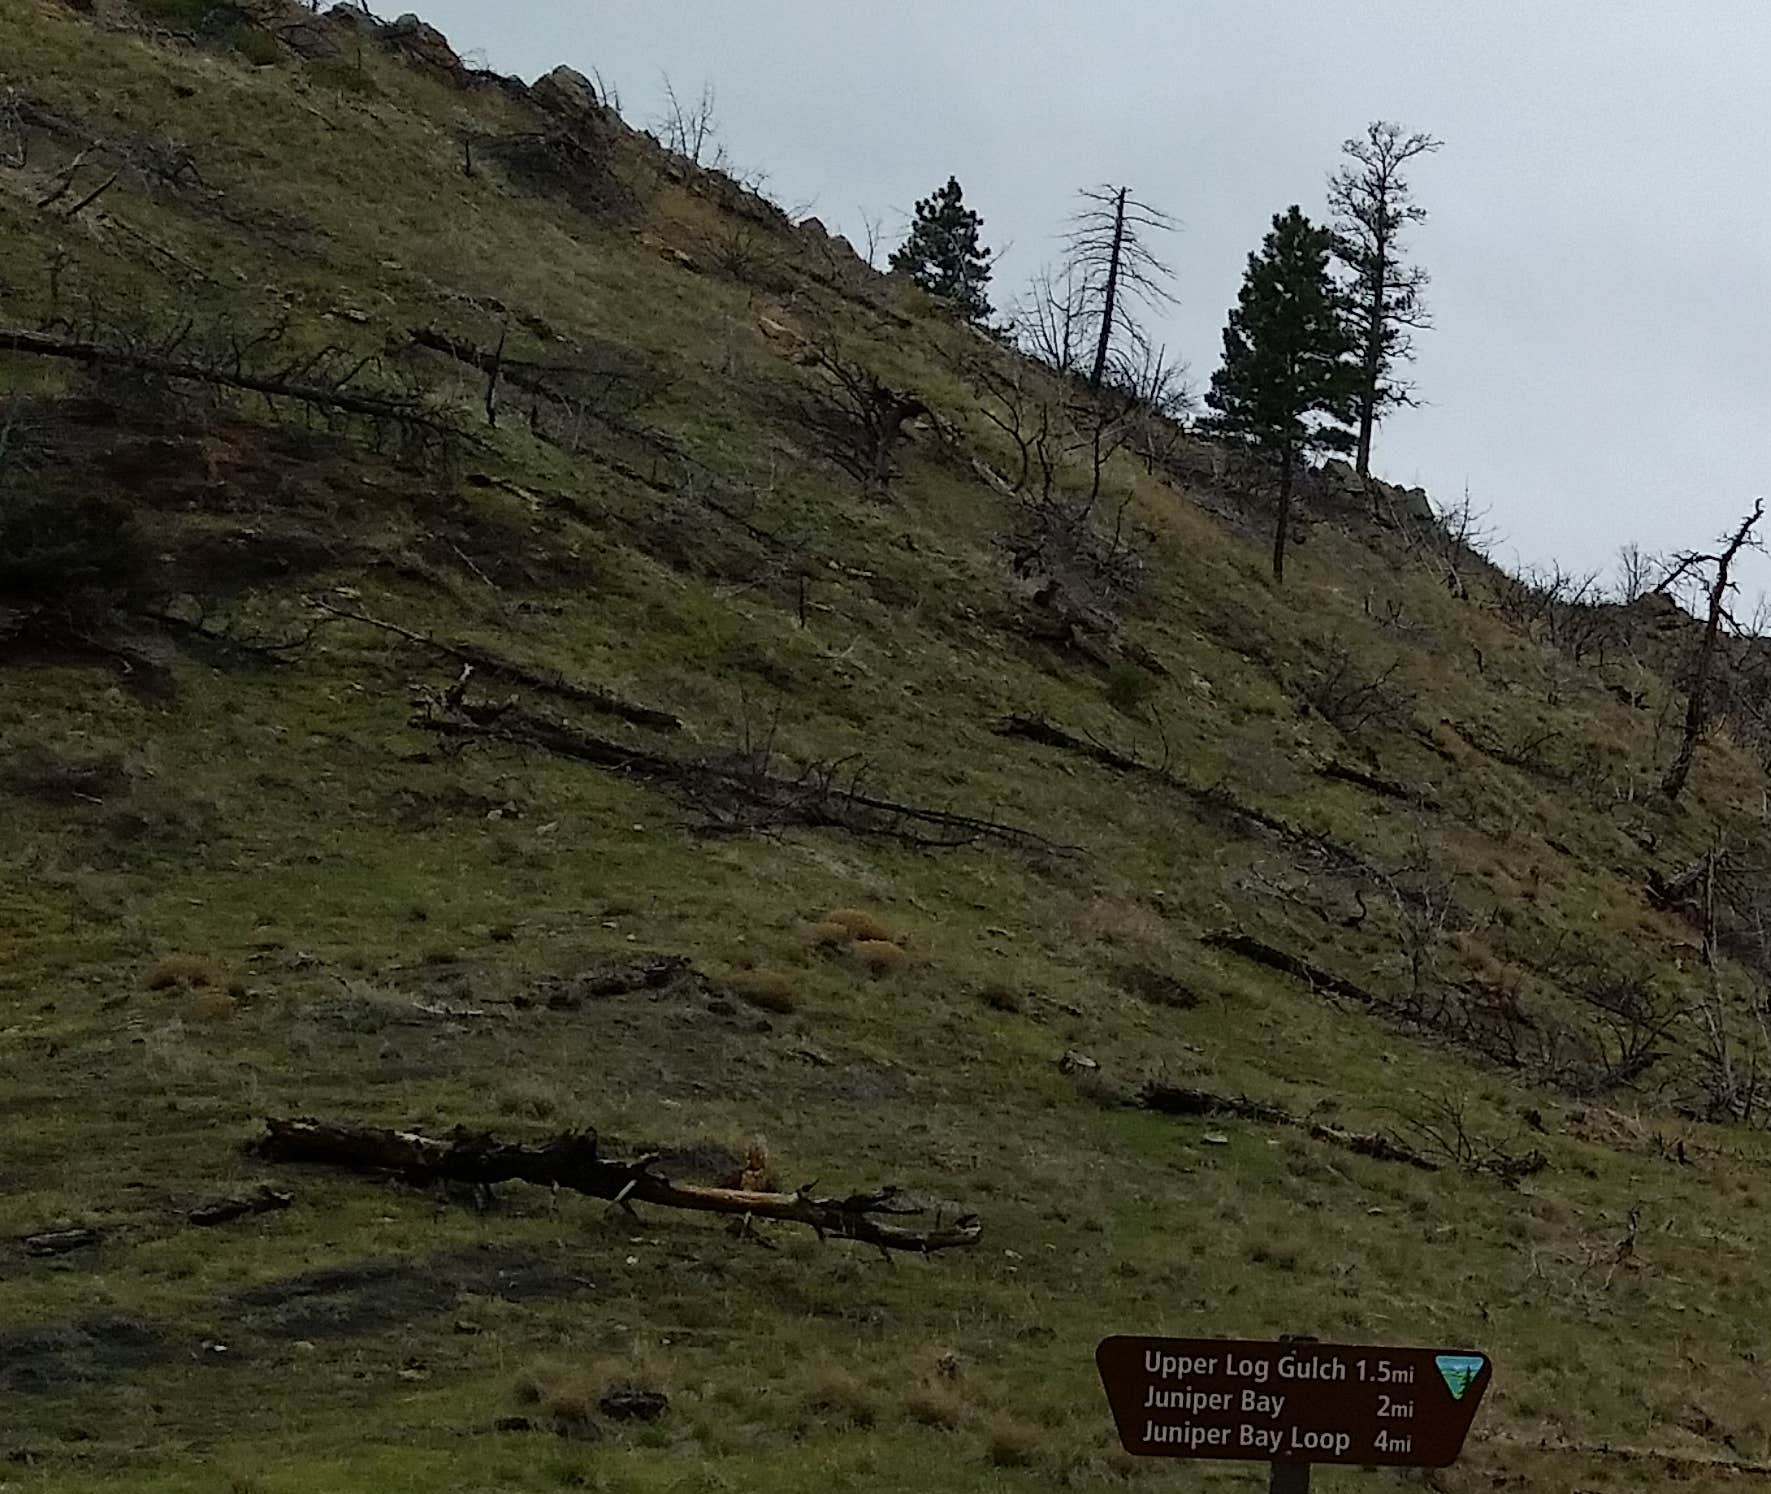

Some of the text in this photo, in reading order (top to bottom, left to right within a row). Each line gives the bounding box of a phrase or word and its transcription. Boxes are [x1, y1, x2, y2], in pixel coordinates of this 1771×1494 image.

[1145, 1350, 1415, 1384] Upper Log Gulch 1.5mi
[1144, 1385, 1414, 1418] Juniper Bay 2mi
[1142, 1420, 1412, 1456] Juniper Bay Loop 4mi
